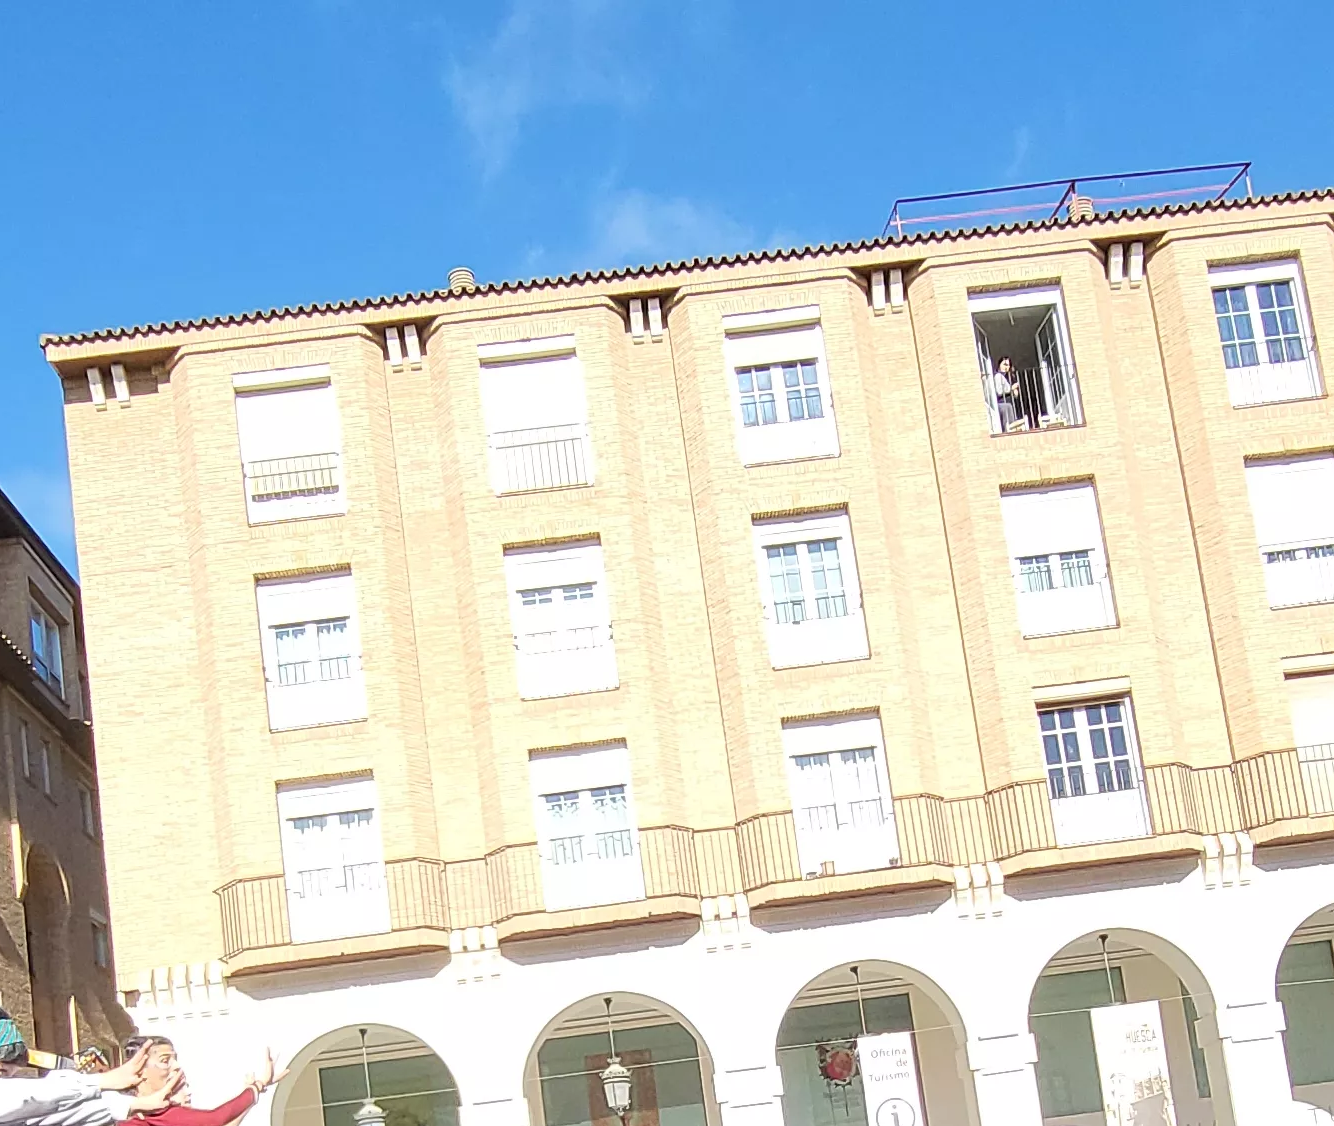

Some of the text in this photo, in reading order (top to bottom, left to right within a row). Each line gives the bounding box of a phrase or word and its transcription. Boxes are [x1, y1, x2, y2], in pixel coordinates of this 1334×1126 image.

[1125, 1028, 1157, 1044] HUESCA
[870, 1047, 907, 1059] Oficina
[896, 1058, 908, 1067] de
[868, 1071, 910, 1082] Turismo
